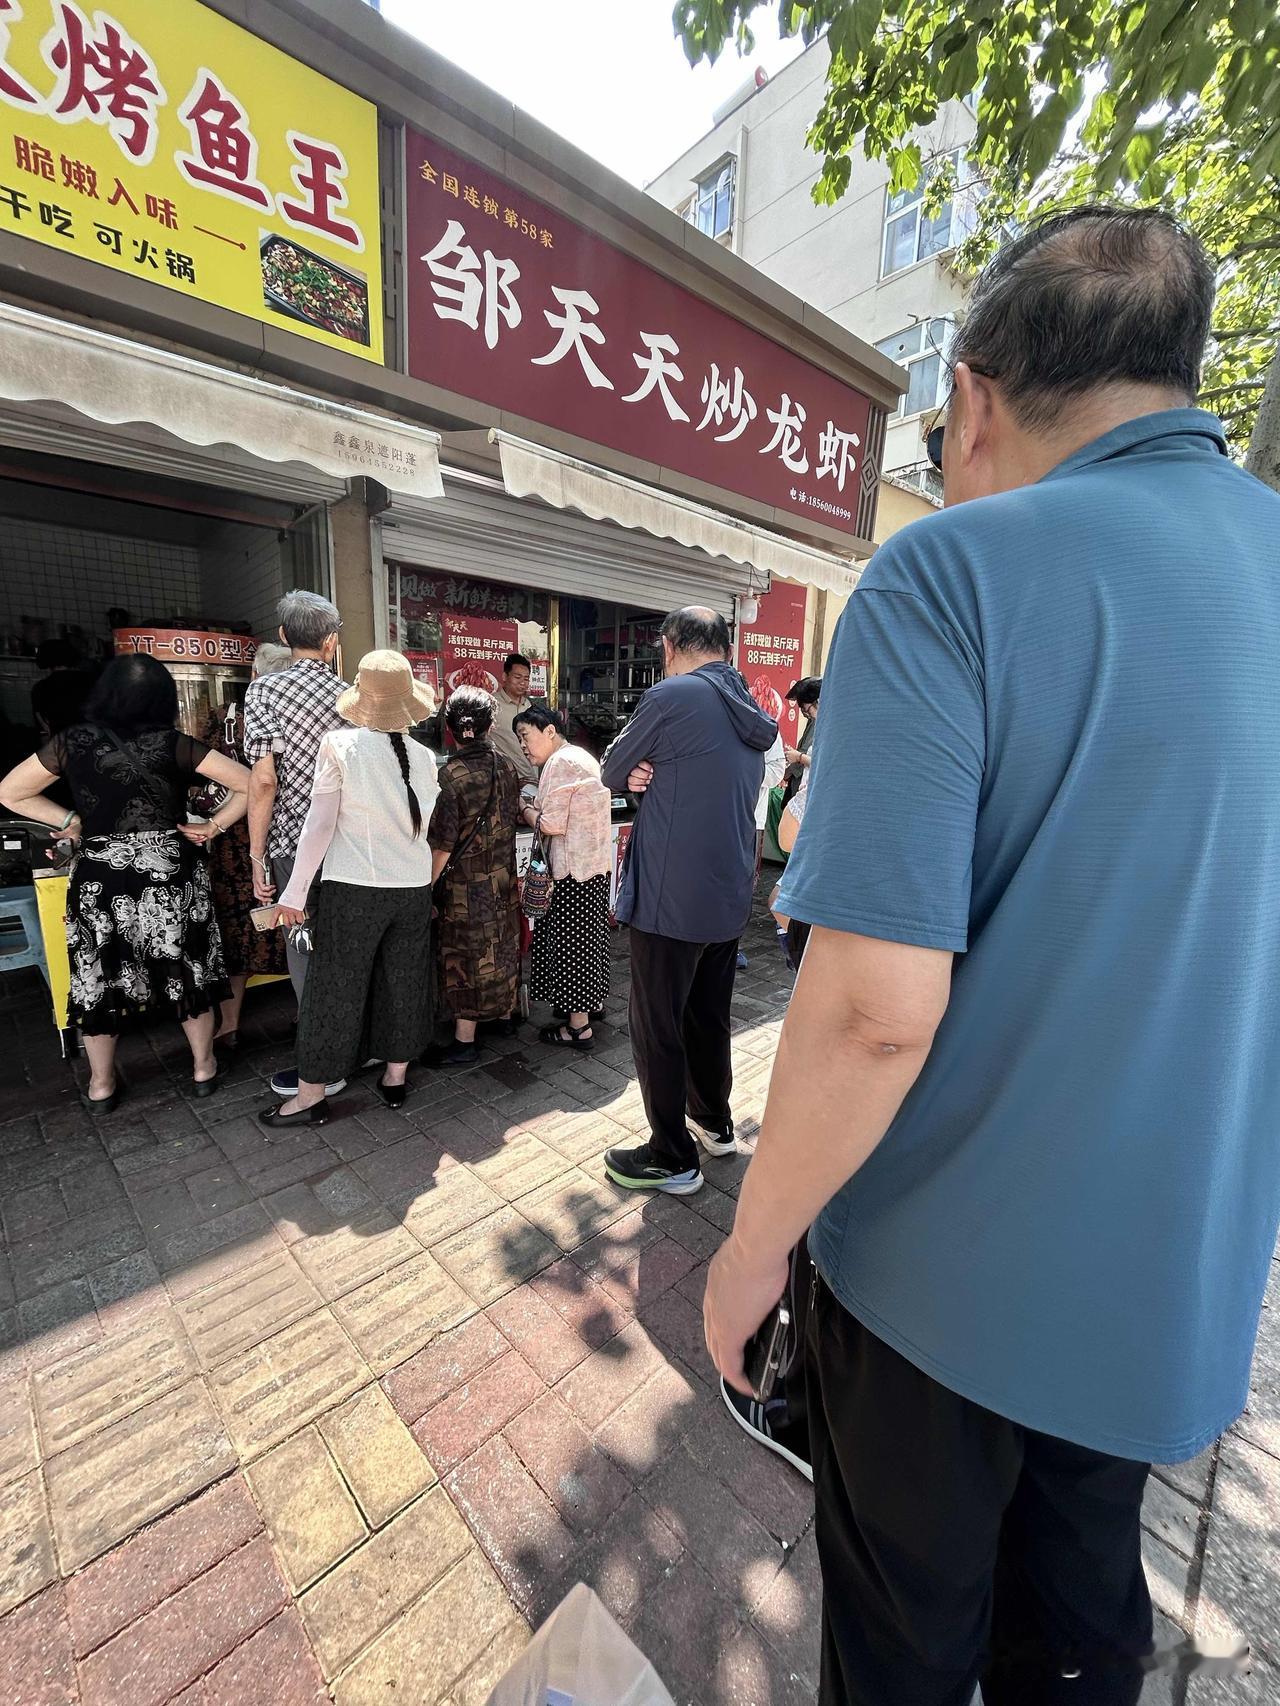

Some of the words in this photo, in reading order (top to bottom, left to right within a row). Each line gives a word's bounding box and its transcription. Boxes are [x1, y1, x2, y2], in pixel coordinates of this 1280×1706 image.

[0, 0, 359, 246] 烤鱼王
[14, 135, 178, 230] 脆嫩入味
[419, 160, 554, 248] 全国连锁第58家
[93, 222, 196, 284] 可火锅
[420, 219, 861, 492] 邹天天炒龙虾
